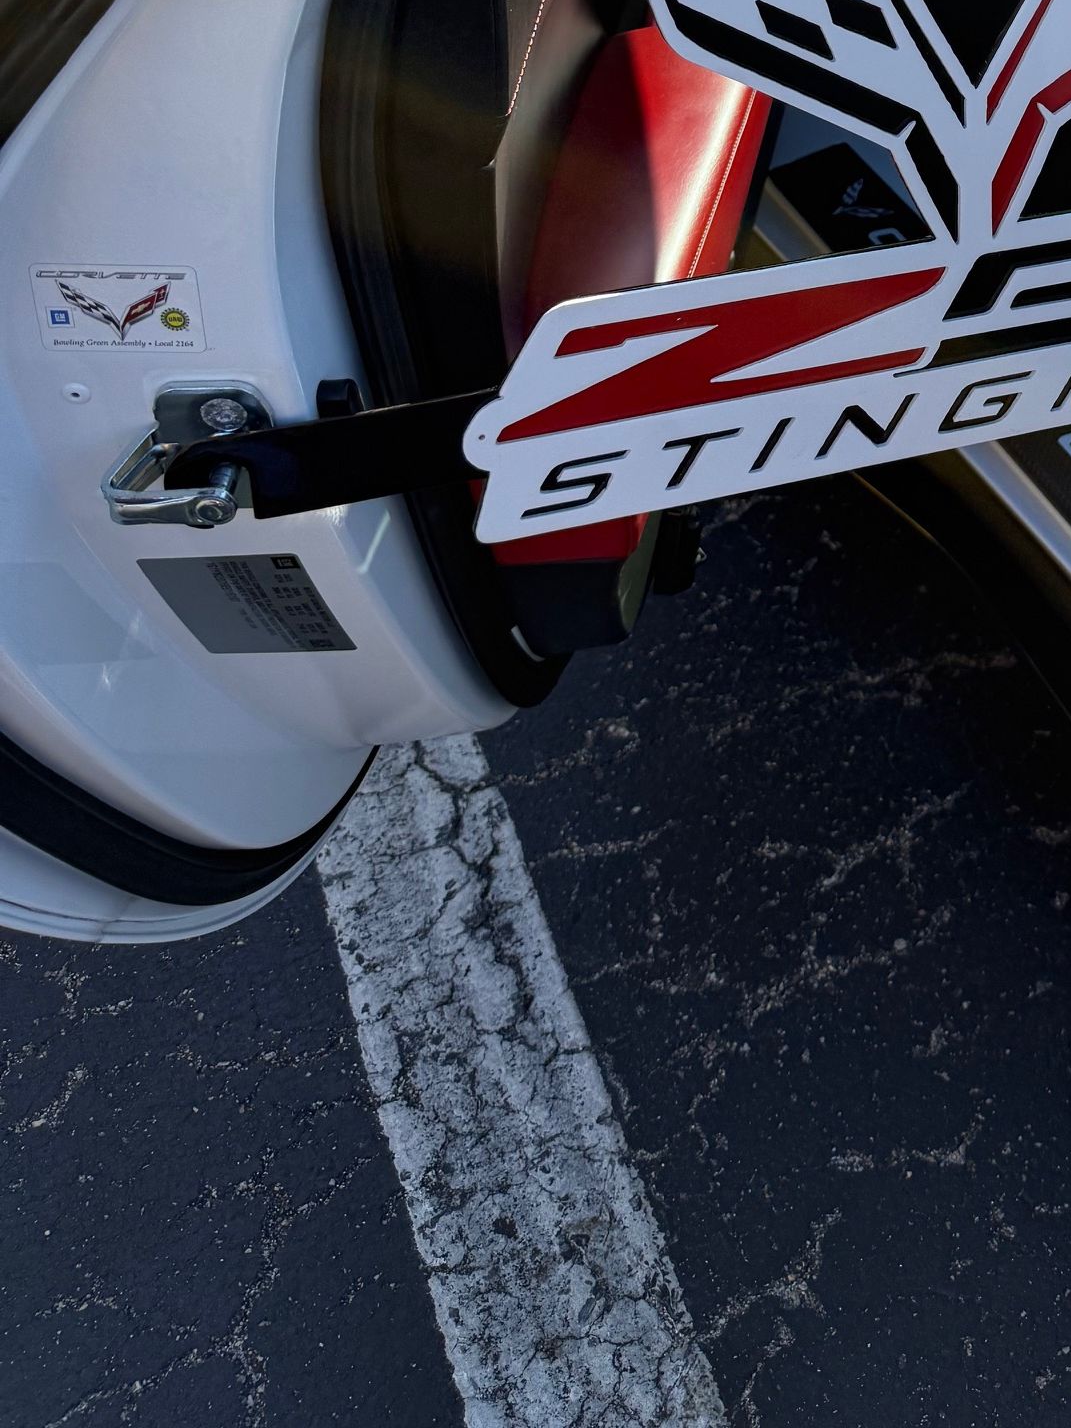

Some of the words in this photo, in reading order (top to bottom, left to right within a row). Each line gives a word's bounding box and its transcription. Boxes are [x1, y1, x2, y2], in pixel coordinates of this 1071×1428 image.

[36, 270, 187, 281] CORVETTE
[53, 339, 84, 347] Bowling
[111, 339, 146, 348] Assembly
